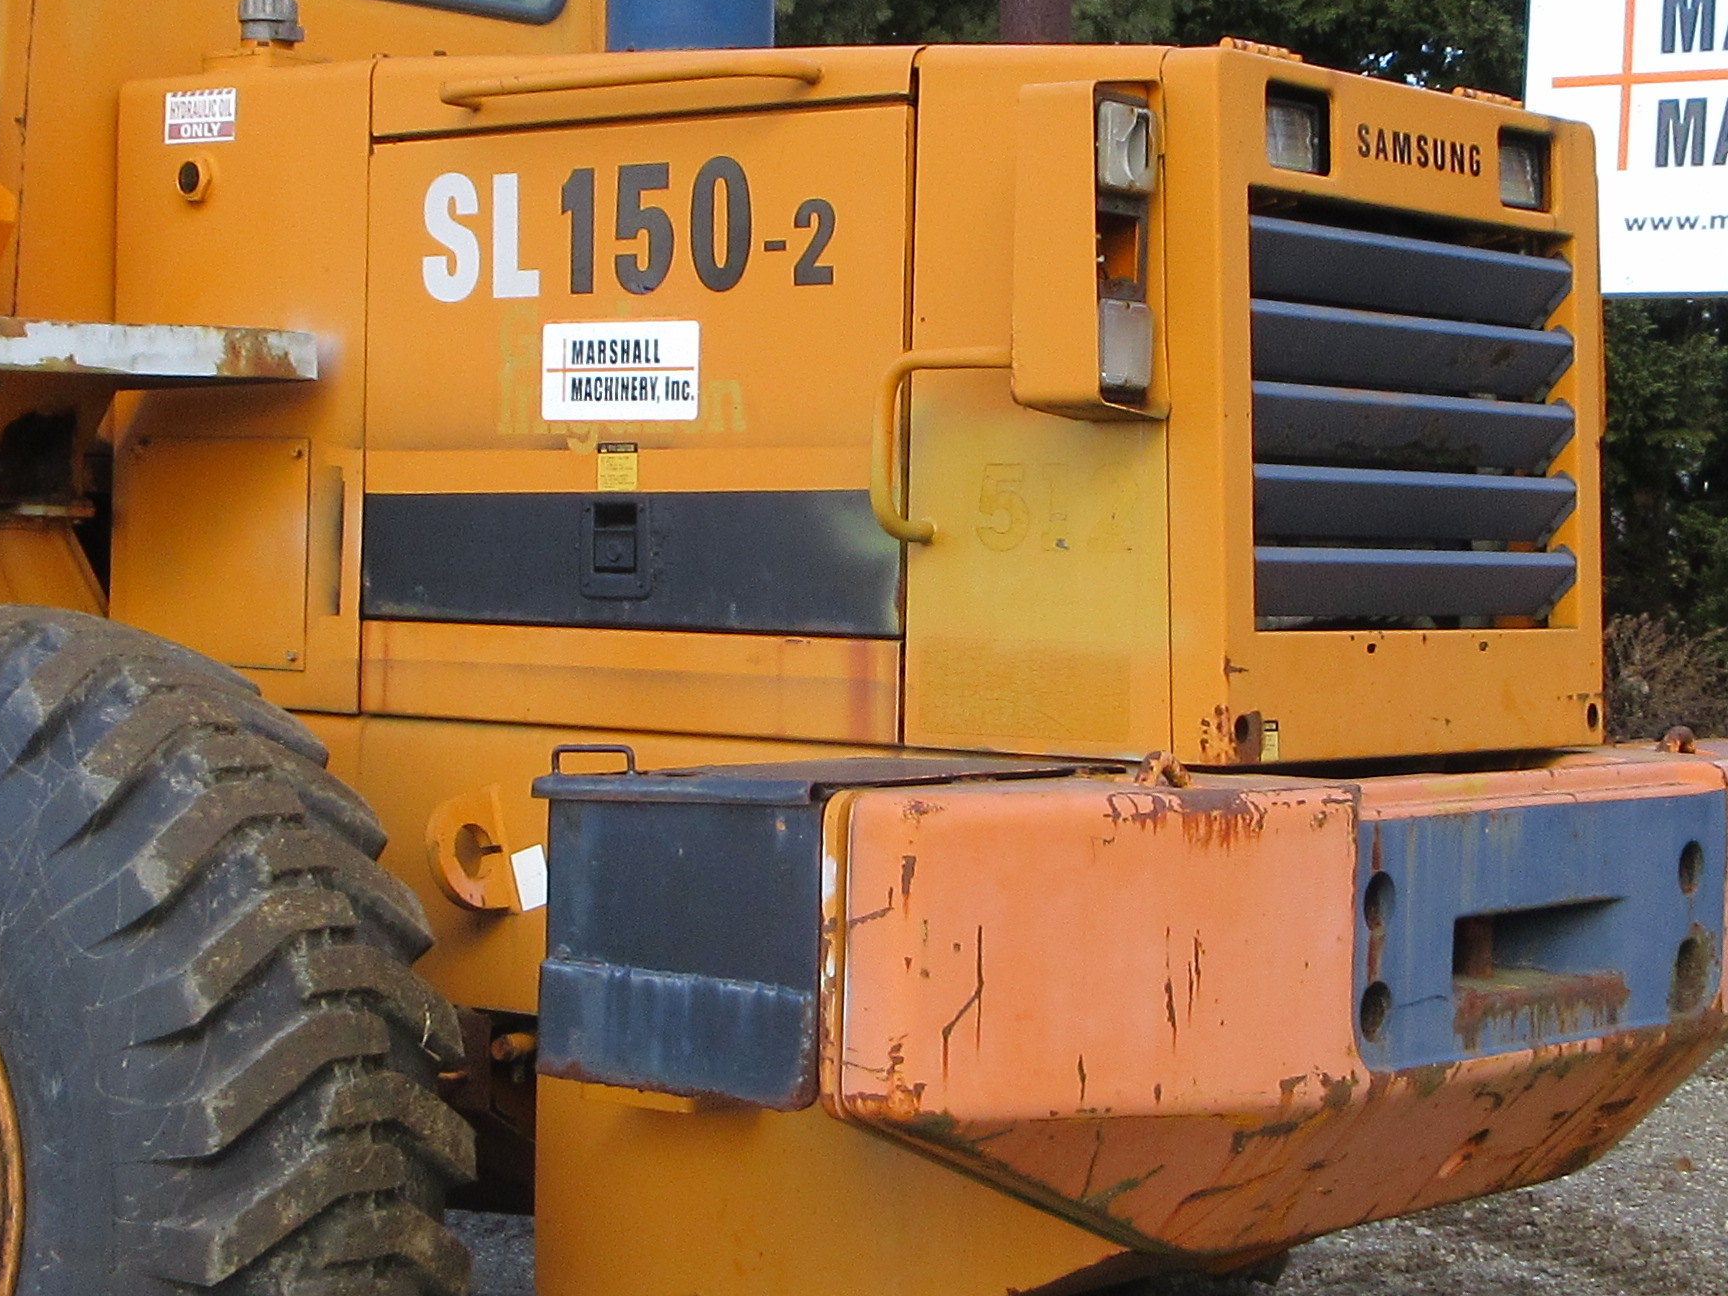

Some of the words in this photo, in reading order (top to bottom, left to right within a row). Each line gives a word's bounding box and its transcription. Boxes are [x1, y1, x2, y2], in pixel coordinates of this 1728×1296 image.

[170, 98, 217, 119] HYDRAULIC
[218, 97, 232, 117] OIL
[179, 122, 221, 138] ONLY
[1357, 123, 1482, 178] SAMSUNG
[571, 339, 661, 365] MARSHALL
[570, 376, 661, 403] MACHINERY,
[665, 376, 695, 402] Inc.
